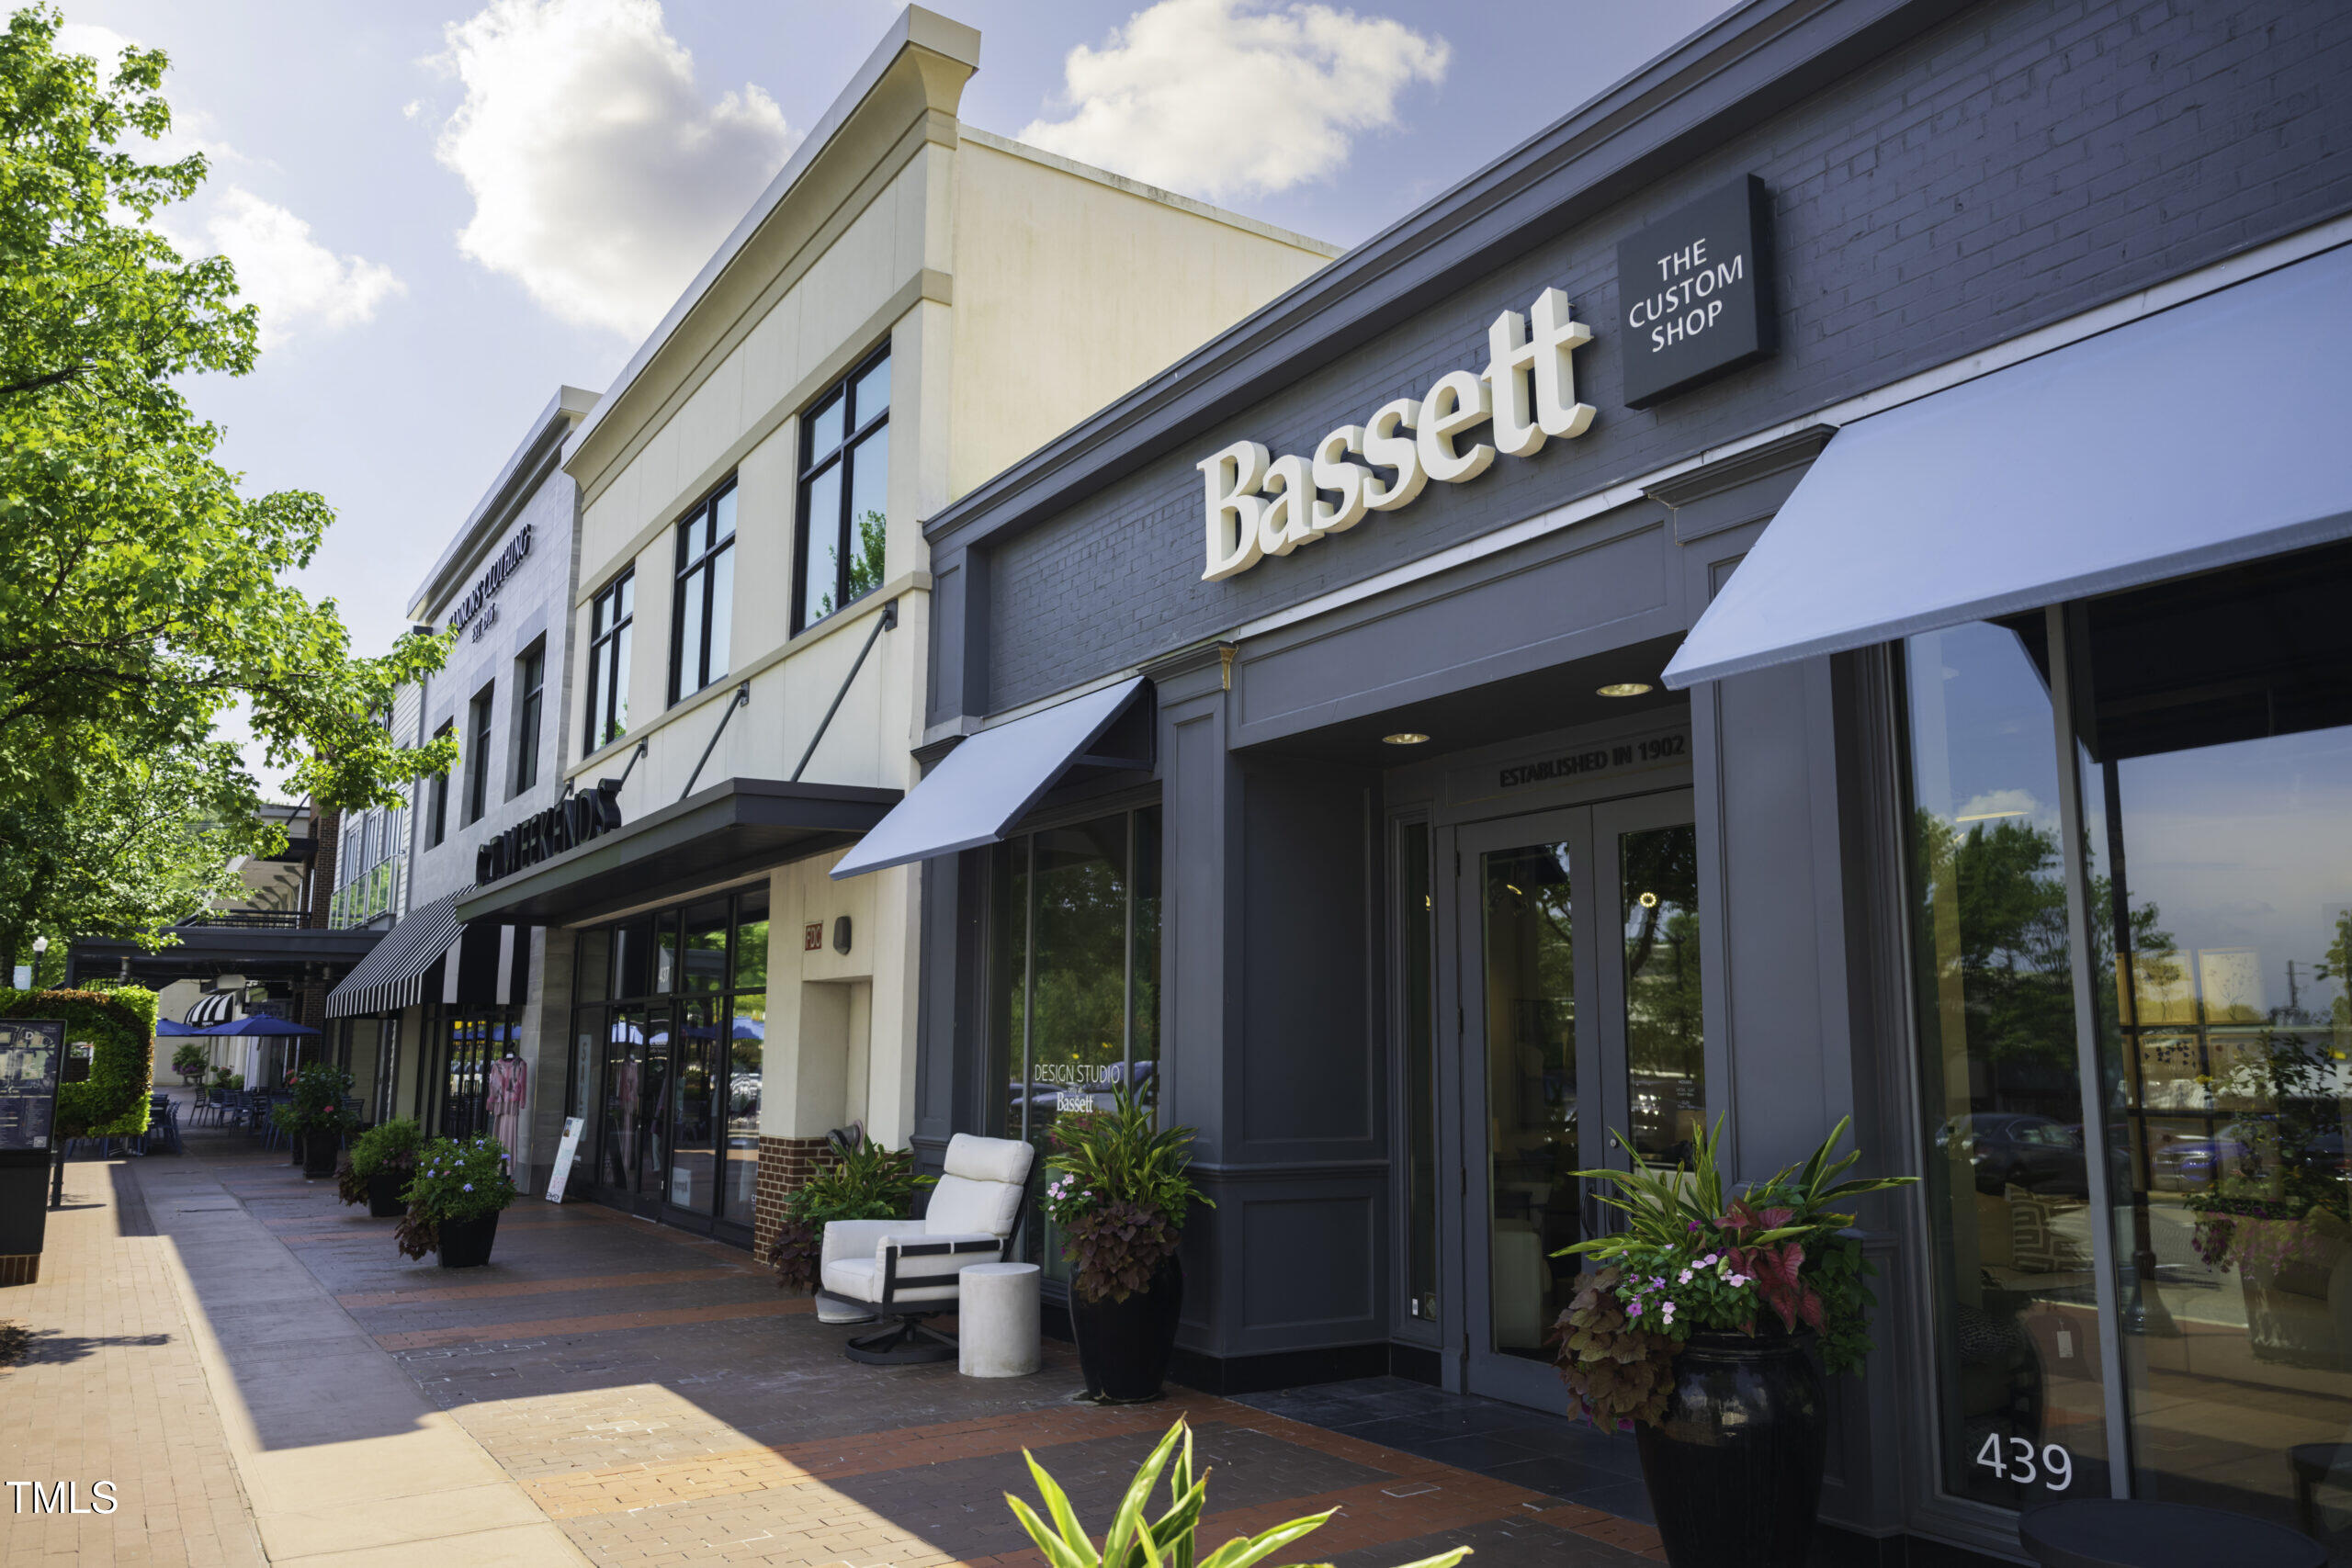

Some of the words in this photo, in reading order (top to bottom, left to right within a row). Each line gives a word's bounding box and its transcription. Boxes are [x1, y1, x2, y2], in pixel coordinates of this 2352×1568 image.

[1657, 238, 1707, 281] THE
[1629, 254, 1743, 328] CUSTOM
[1652, 299, 1723, 353] SHOP
[1196, 287, 1597, 581] Bassett
[484, 524, 532, 599] CLOTHING
[1499, 750, 1608, 788] ESTABLISHED
[1612, 745, 1633, 766] IN
[1638, 735, 1685, 761] 1902
[1035, 1064, 1074, 1082] DESIGN
[1077, 1065, 1120, 1084] STUDIO
[1057, 1091, 1093, 1112] Bassett
[1976, 1432, 2073, 1491] 439
